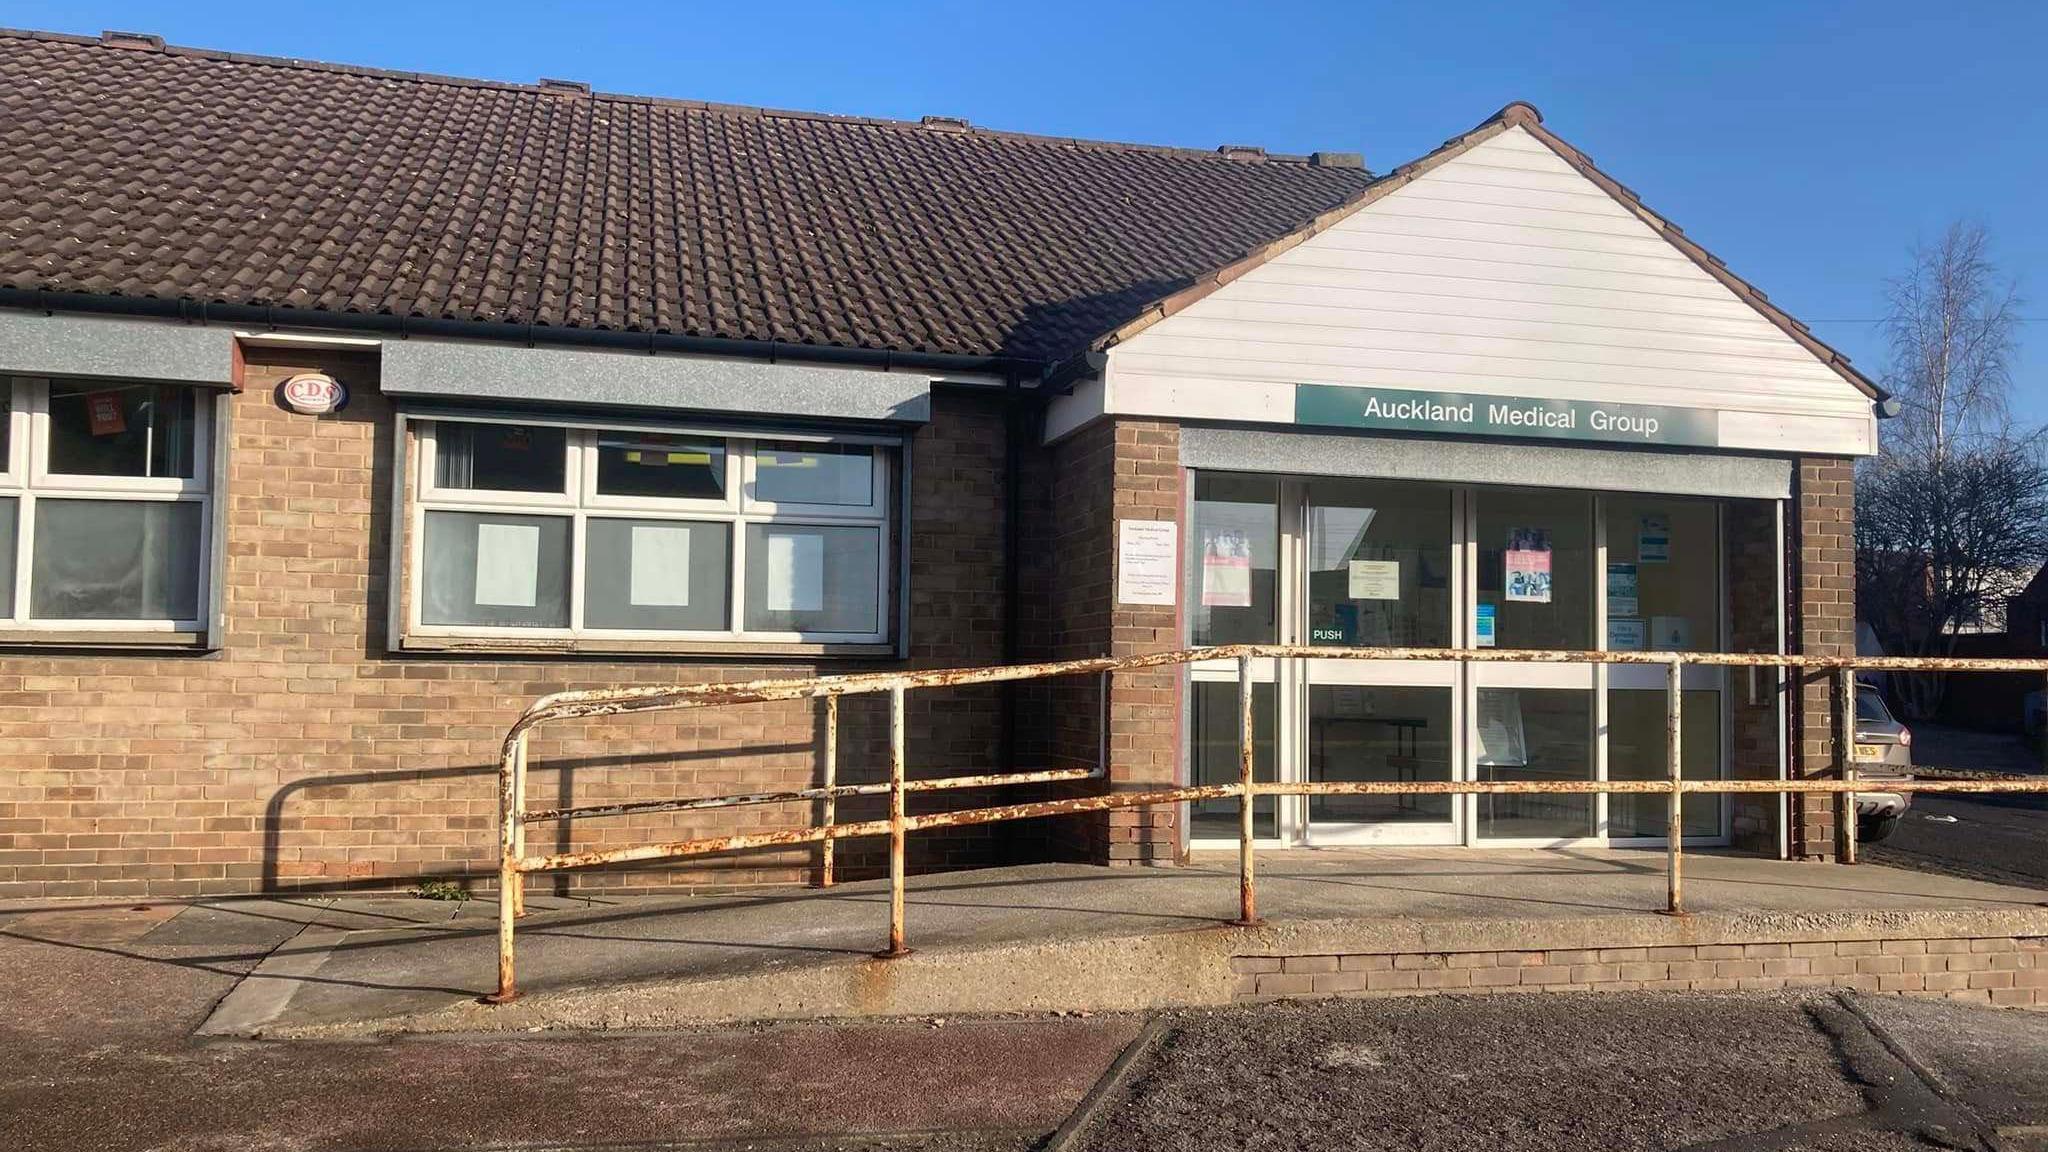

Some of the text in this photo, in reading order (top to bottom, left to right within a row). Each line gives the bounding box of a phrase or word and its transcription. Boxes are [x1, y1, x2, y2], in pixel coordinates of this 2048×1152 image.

[1364, 396, 1659, 438] Auckland Medical Group
[1313, 630, 1342, 640] PUSH
